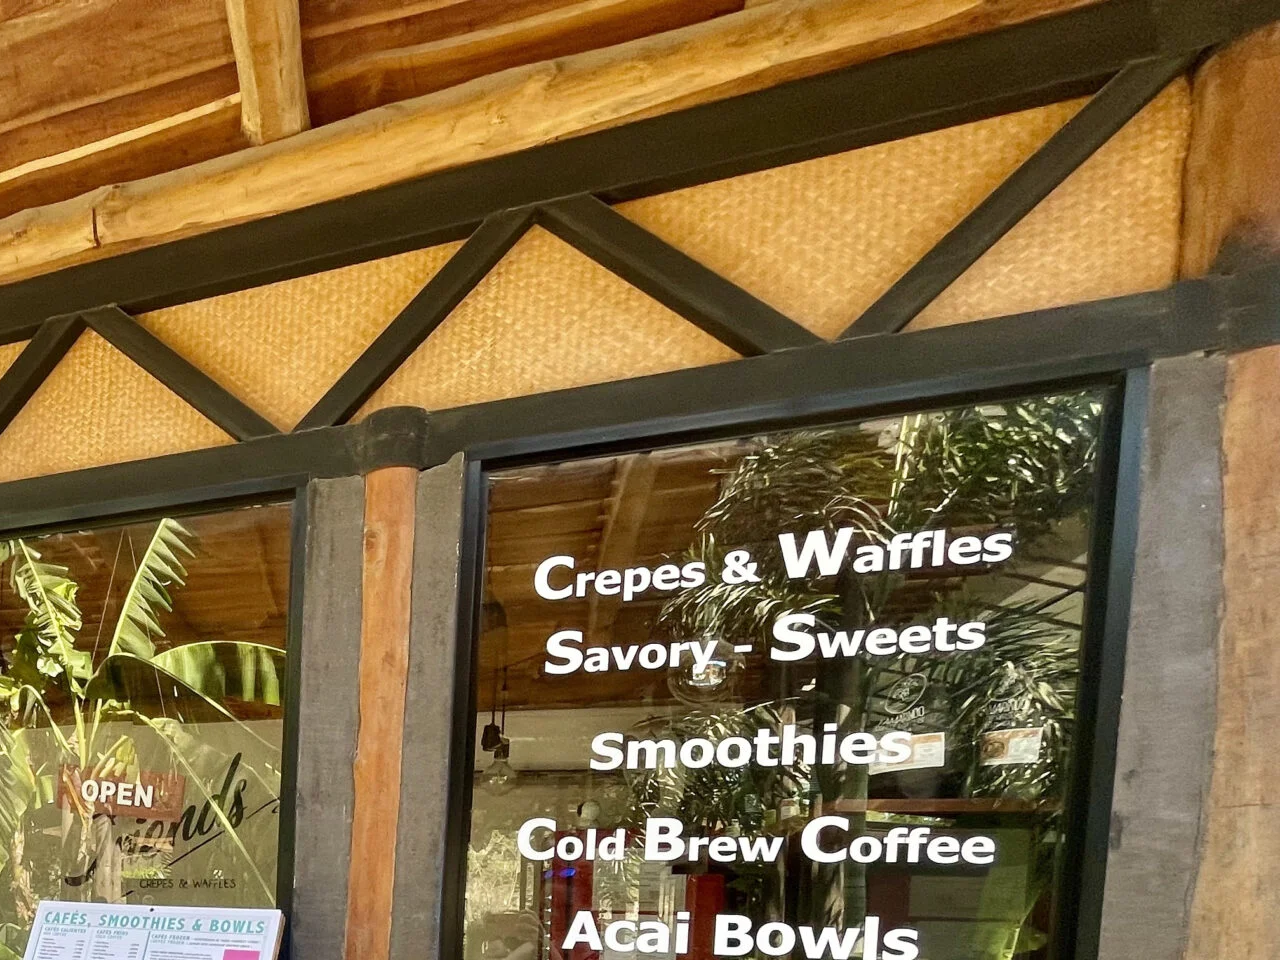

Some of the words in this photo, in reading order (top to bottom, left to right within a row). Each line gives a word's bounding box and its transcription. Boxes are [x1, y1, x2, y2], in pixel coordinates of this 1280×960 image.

[533, 554, 707, 601] Crepes
[721, 548, 759, 585] &
[777, 526, 1014, 580] Waffles
[543, 630, 717, 676] Savory
[769, 613, 987, 662] Sweets
[589, 722, 913, 771] Smoothies
[81, 779, 155, 809] OPEN
[517, 816, 626, 862] Cold
[643, 816, 785, 863] Brew
[800, 815, 997, 866] Coffee
[139, 878, 174, 889] CREPES
[193, 878, 237, 889] WAFFLES
[99, 914, 186, 931] SMOOTHIES
[191, 918, 203, 931] &
[209, 919, 265, 934] BOWLS
[561, 910, 688, 955] Acai
